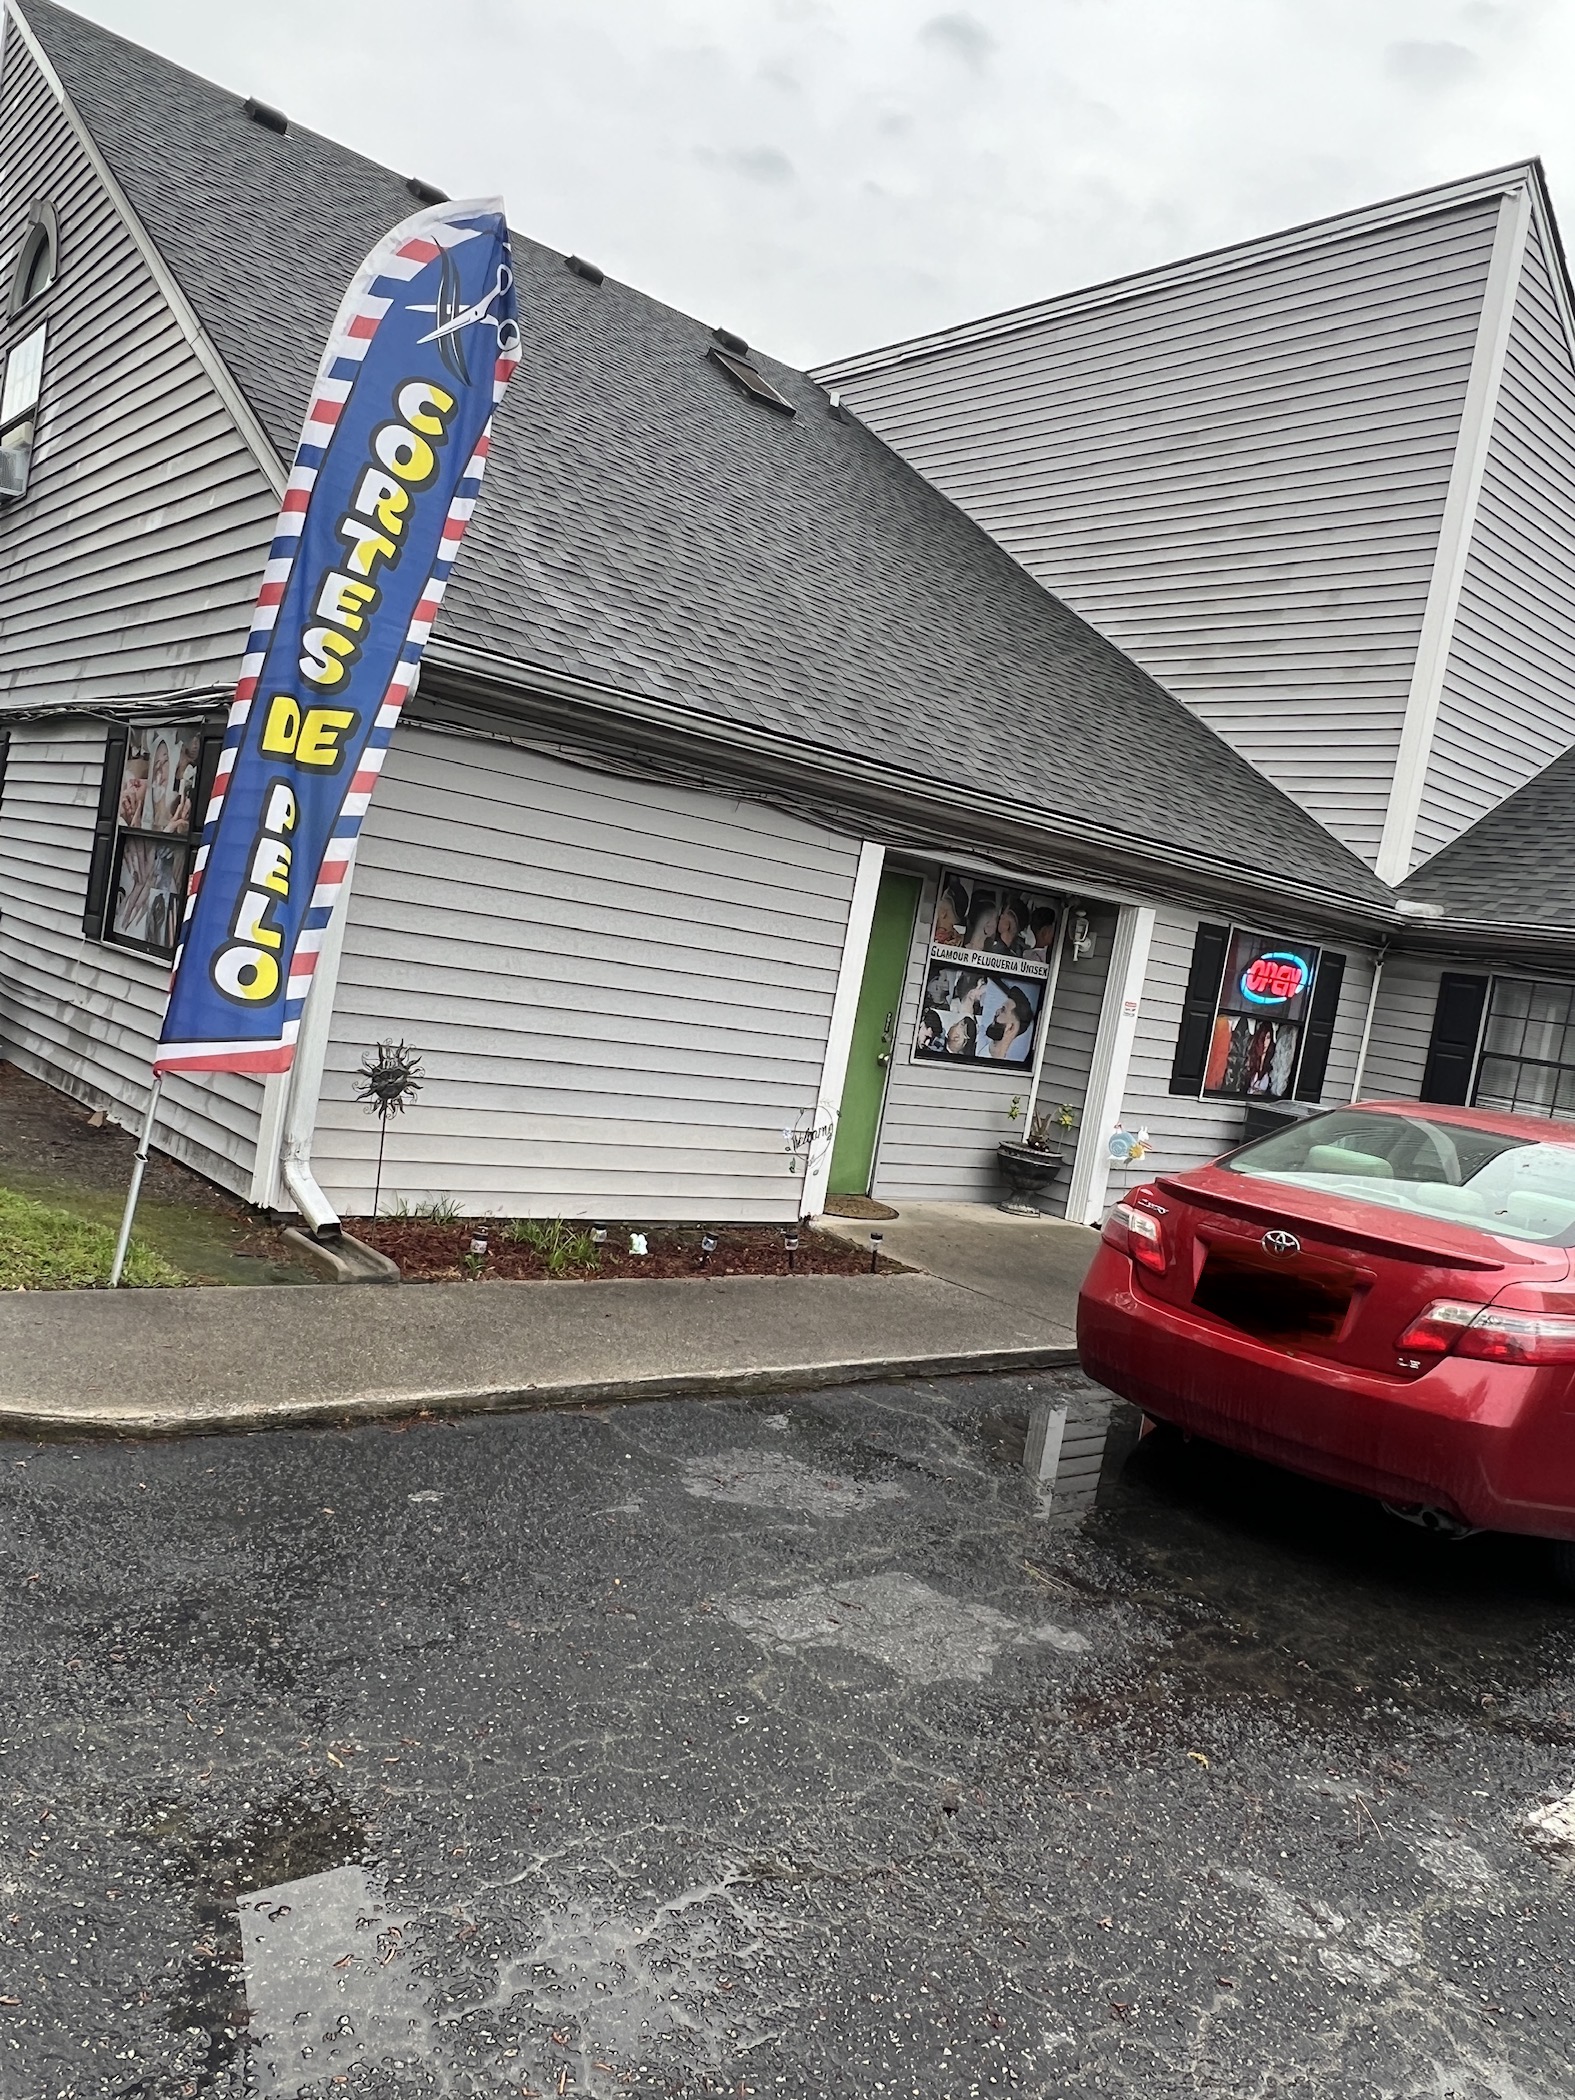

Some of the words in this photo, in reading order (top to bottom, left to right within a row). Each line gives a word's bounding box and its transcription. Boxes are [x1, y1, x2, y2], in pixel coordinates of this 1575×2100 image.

[298, 381, 454, 686] CORTES
[261, 695, 355, 767] DE
[213, 783, 296, 1001] PELO
[930, 945, 969, 963] GLAMOUR
[971, 952, 1018, 972] PELUQUERIA
[1020, 961, 1049, 977] UNISEX
[1246, 959, 1302, 998] OPEN
